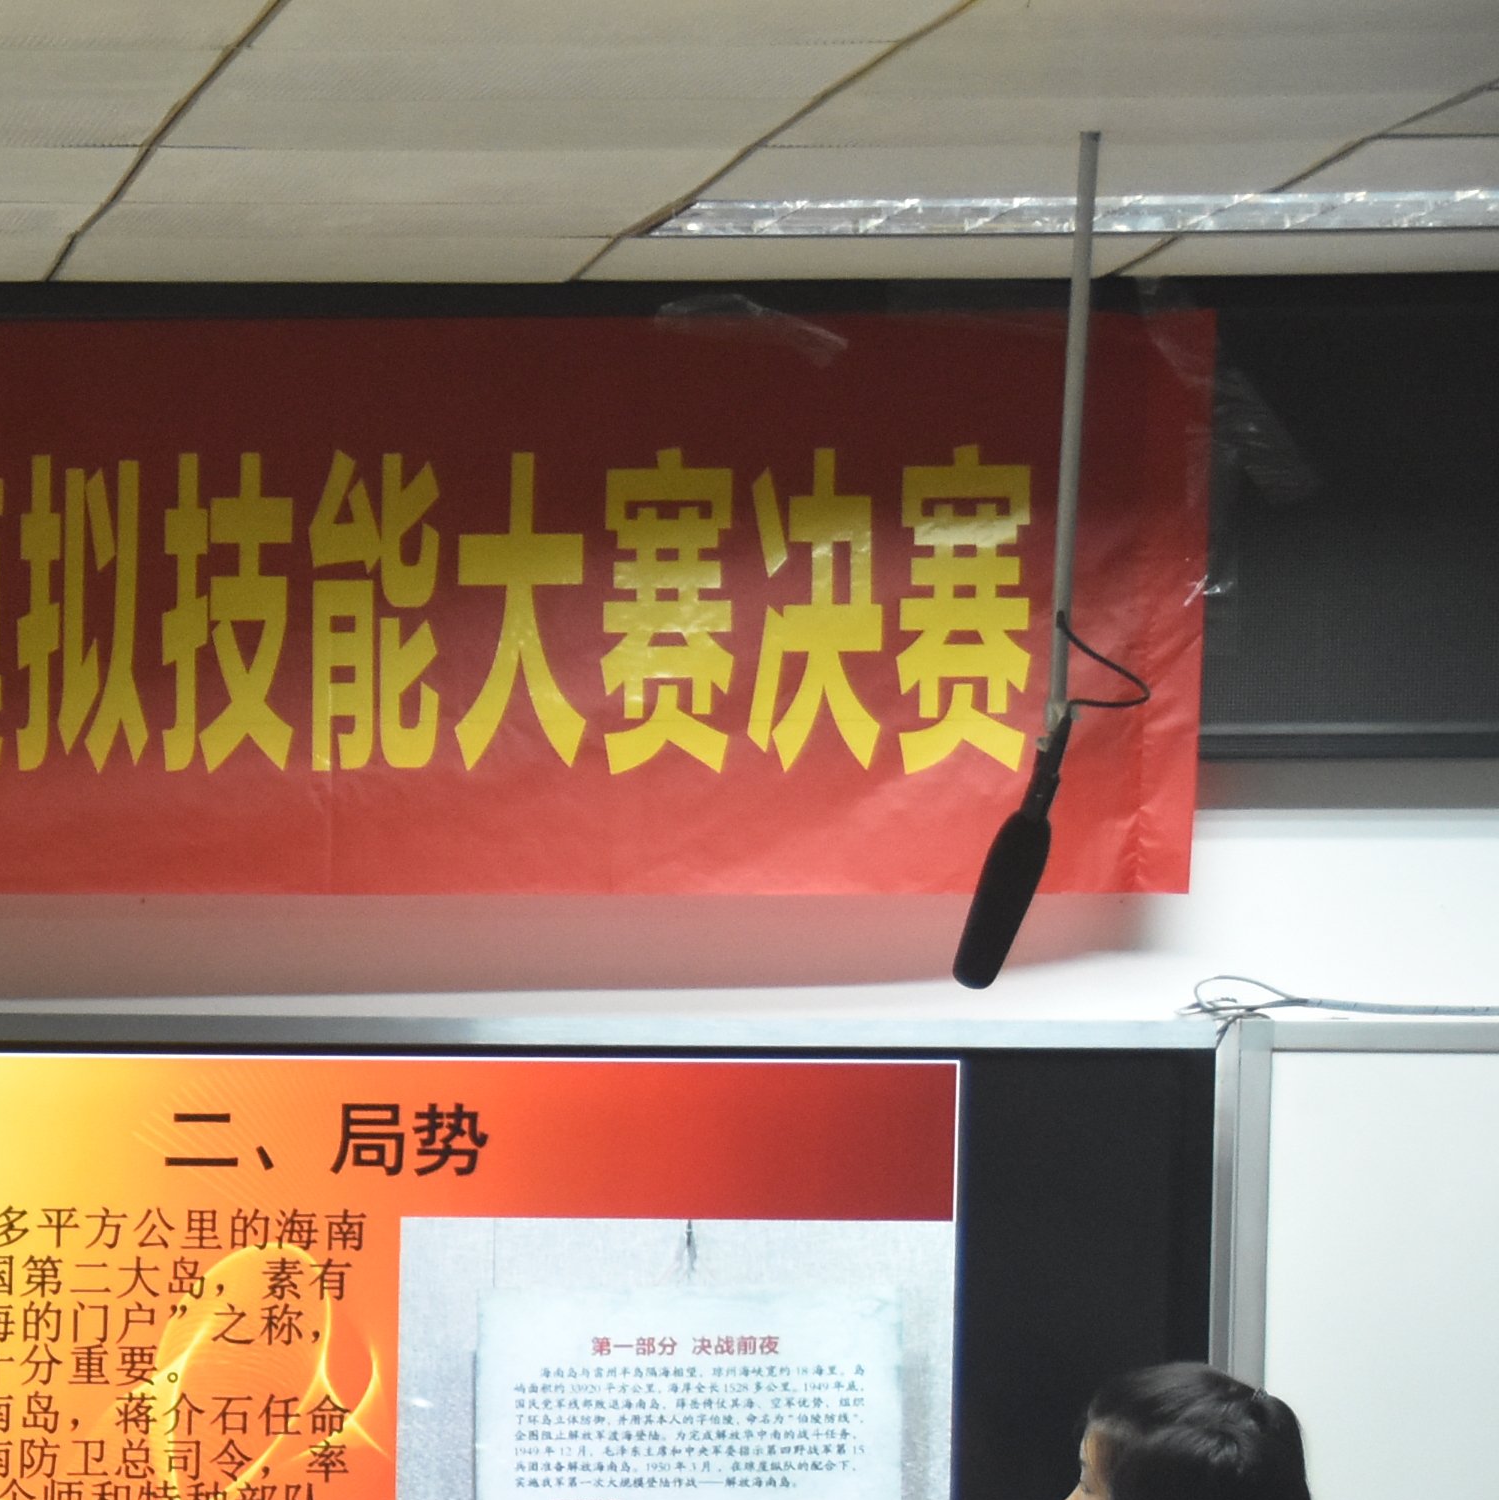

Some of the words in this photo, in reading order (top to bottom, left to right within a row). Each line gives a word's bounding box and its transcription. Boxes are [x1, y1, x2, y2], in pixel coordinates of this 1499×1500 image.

[165, 1102, 488, 1176] 二、局势
[592, 1337, 677, 1356] 第一部分
[692, 1335, 780, 1355] 决战前夜
